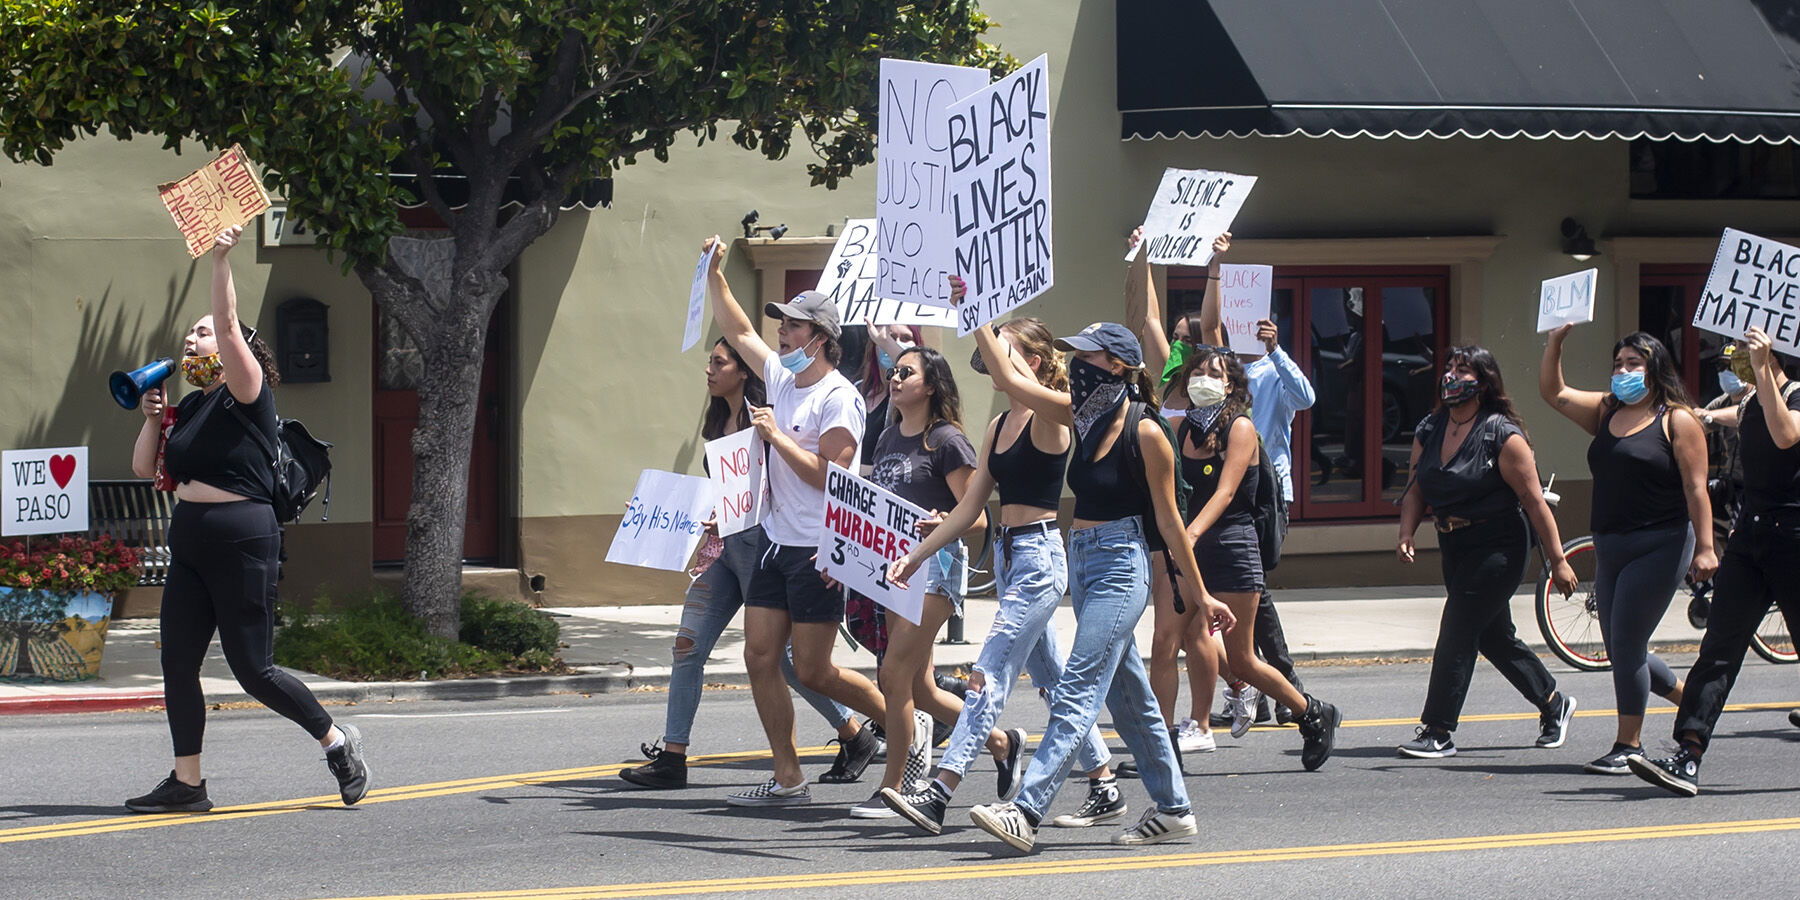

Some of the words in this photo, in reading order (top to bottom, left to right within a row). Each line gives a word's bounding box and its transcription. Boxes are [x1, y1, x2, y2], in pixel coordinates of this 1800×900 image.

[886, 79, 957, 152] NO
[948, 68, 1046, 173] BLACK
[205, 183, 229, 212] IS
[214, 153, 266, 218] ENOUGH
[879, 157, 952, 214] JUSTI
[954, 142, 1037, 238] LIVES
[1170, 176, 1234, 208] SILENCE
[184, 176, 224, 236] FUCKIN
[1179, 211, 1195, 231] IS
[879, 217, 923, 257] NO
[955, 199, 1050, 304] MATTER
[1147, 233, 1203, 259] VIOLENCE
[1734, 238, 1800, 278] BLAC
[879, 257, 948, 300] PEACE
[1543, 275, 1591, 315] BLM
[1728, 269, 1800, 309] LIVE
[963, 301, 980, 332] SAY
[988, 292, 1001, 318] IT
[1006, 266, 1048, 308] AGAIN.
[1223, 294, 1253, 308] Lives
[12, 460, 46, 487] WE
[720, 447, 750, 483] NO
[16, 493, 71, 523] PASO
[723, 491, 753, 523] NO
[828, 471, 877, 518] CHARGE
[622, 496, 647, 539] Say
[669, 509, 699, 535] Name
[825, 501, 911, 562] MURDERS
[830, 536, 860, 566] 3RD
